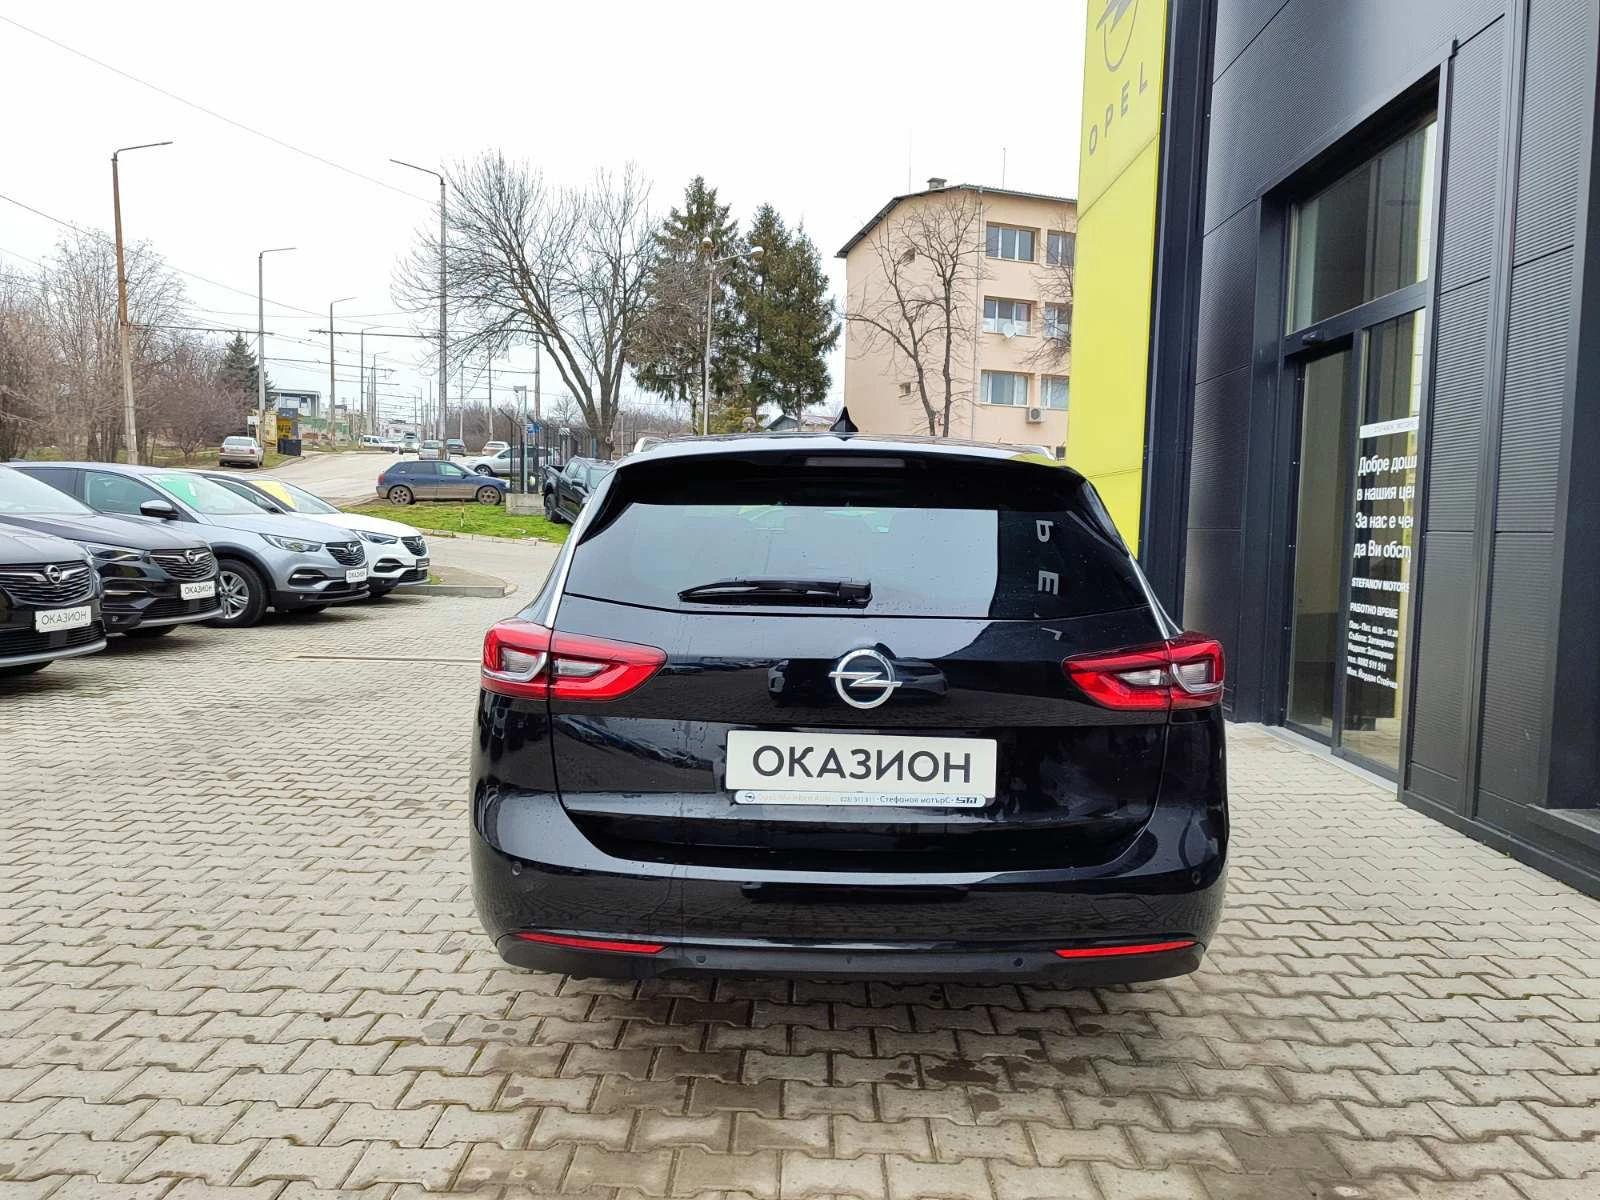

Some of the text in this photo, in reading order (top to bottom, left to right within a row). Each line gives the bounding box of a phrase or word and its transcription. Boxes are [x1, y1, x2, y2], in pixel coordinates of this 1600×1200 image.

[1088, 61, 1148, 156] OPEL
[1358, 455, 1389, 476] Добре
[1356, 488, 1363, 501] в
[1364, 486, 1397, 501] нашия
[1355, 512, 1368, 528] За
[1369, 515, 1387, 528] нас
[1389, 515, 1396, 528] е
[1353, 543, 1366, 558] да
[1368, 540, 1381, 557] Ви
[1352, 577, 1409, 593] STEFANOV MOTORS
[41, 610, 87, 625] ОКАЗИОН
[1350, 602, 1398, 619] РАБОТНО ВРЕМЕ
[753, 745, 971, 784] ОКАЗИОН
